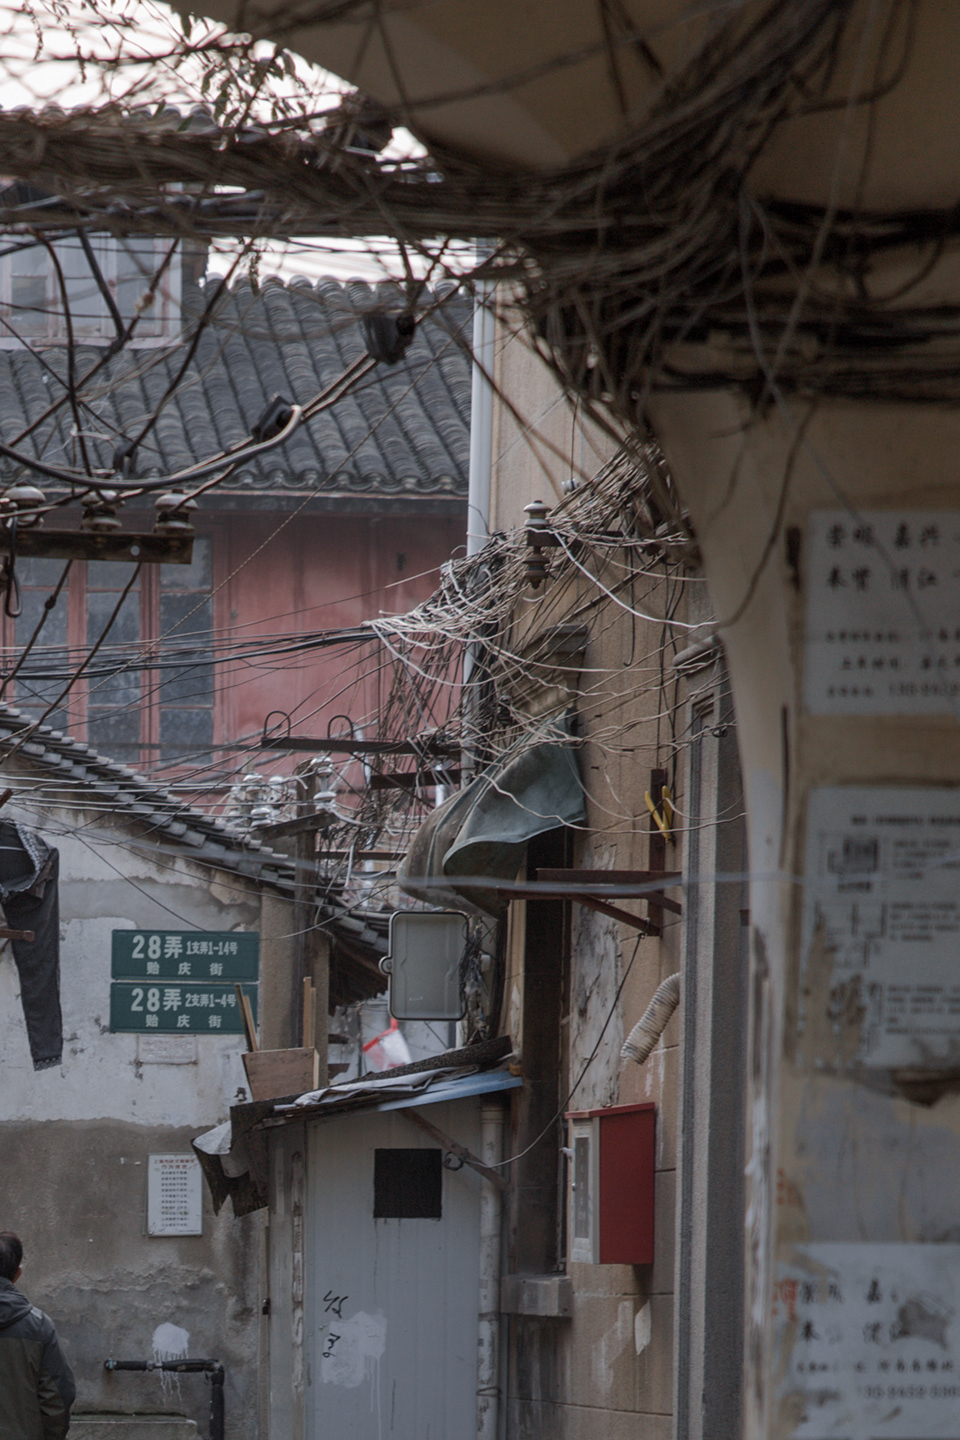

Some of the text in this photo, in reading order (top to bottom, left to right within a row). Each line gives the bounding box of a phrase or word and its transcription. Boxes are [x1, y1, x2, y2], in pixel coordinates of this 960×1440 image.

[146, 961, 224, 976] 贻庆街
[145, 1014, 223, 1029] 贻庆街
